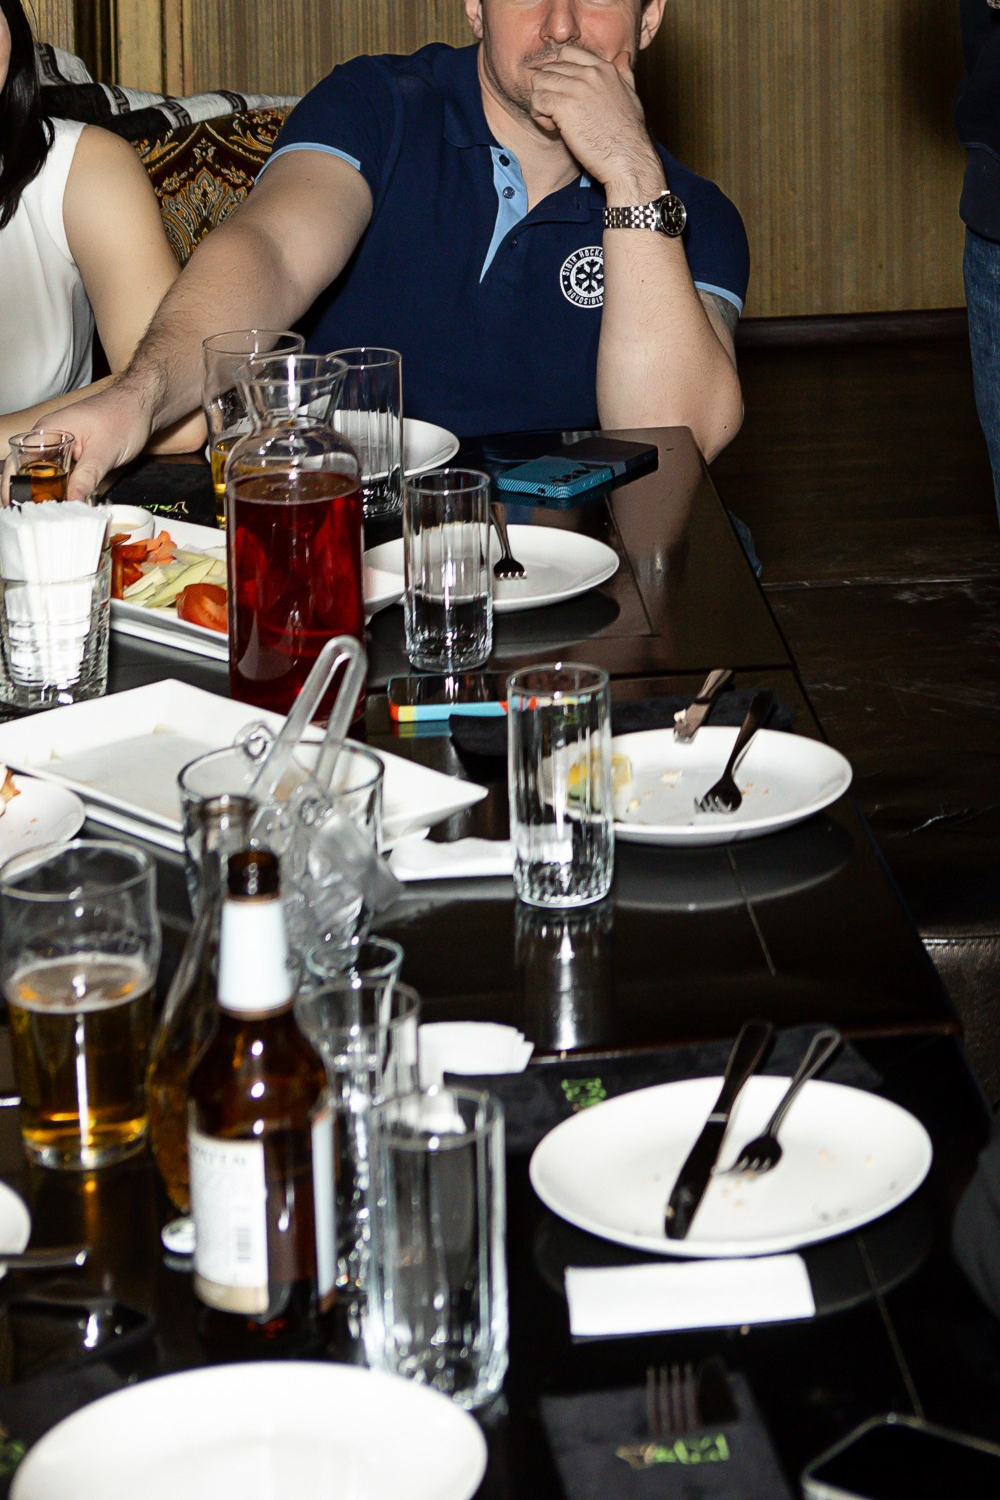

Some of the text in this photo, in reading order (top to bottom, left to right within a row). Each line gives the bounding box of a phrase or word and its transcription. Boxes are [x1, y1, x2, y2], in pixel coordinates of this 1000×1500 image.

[562, 249, 604, 277] SIBIR HOCKE
[566, 288, 604, 305] NOVOSIBIR
